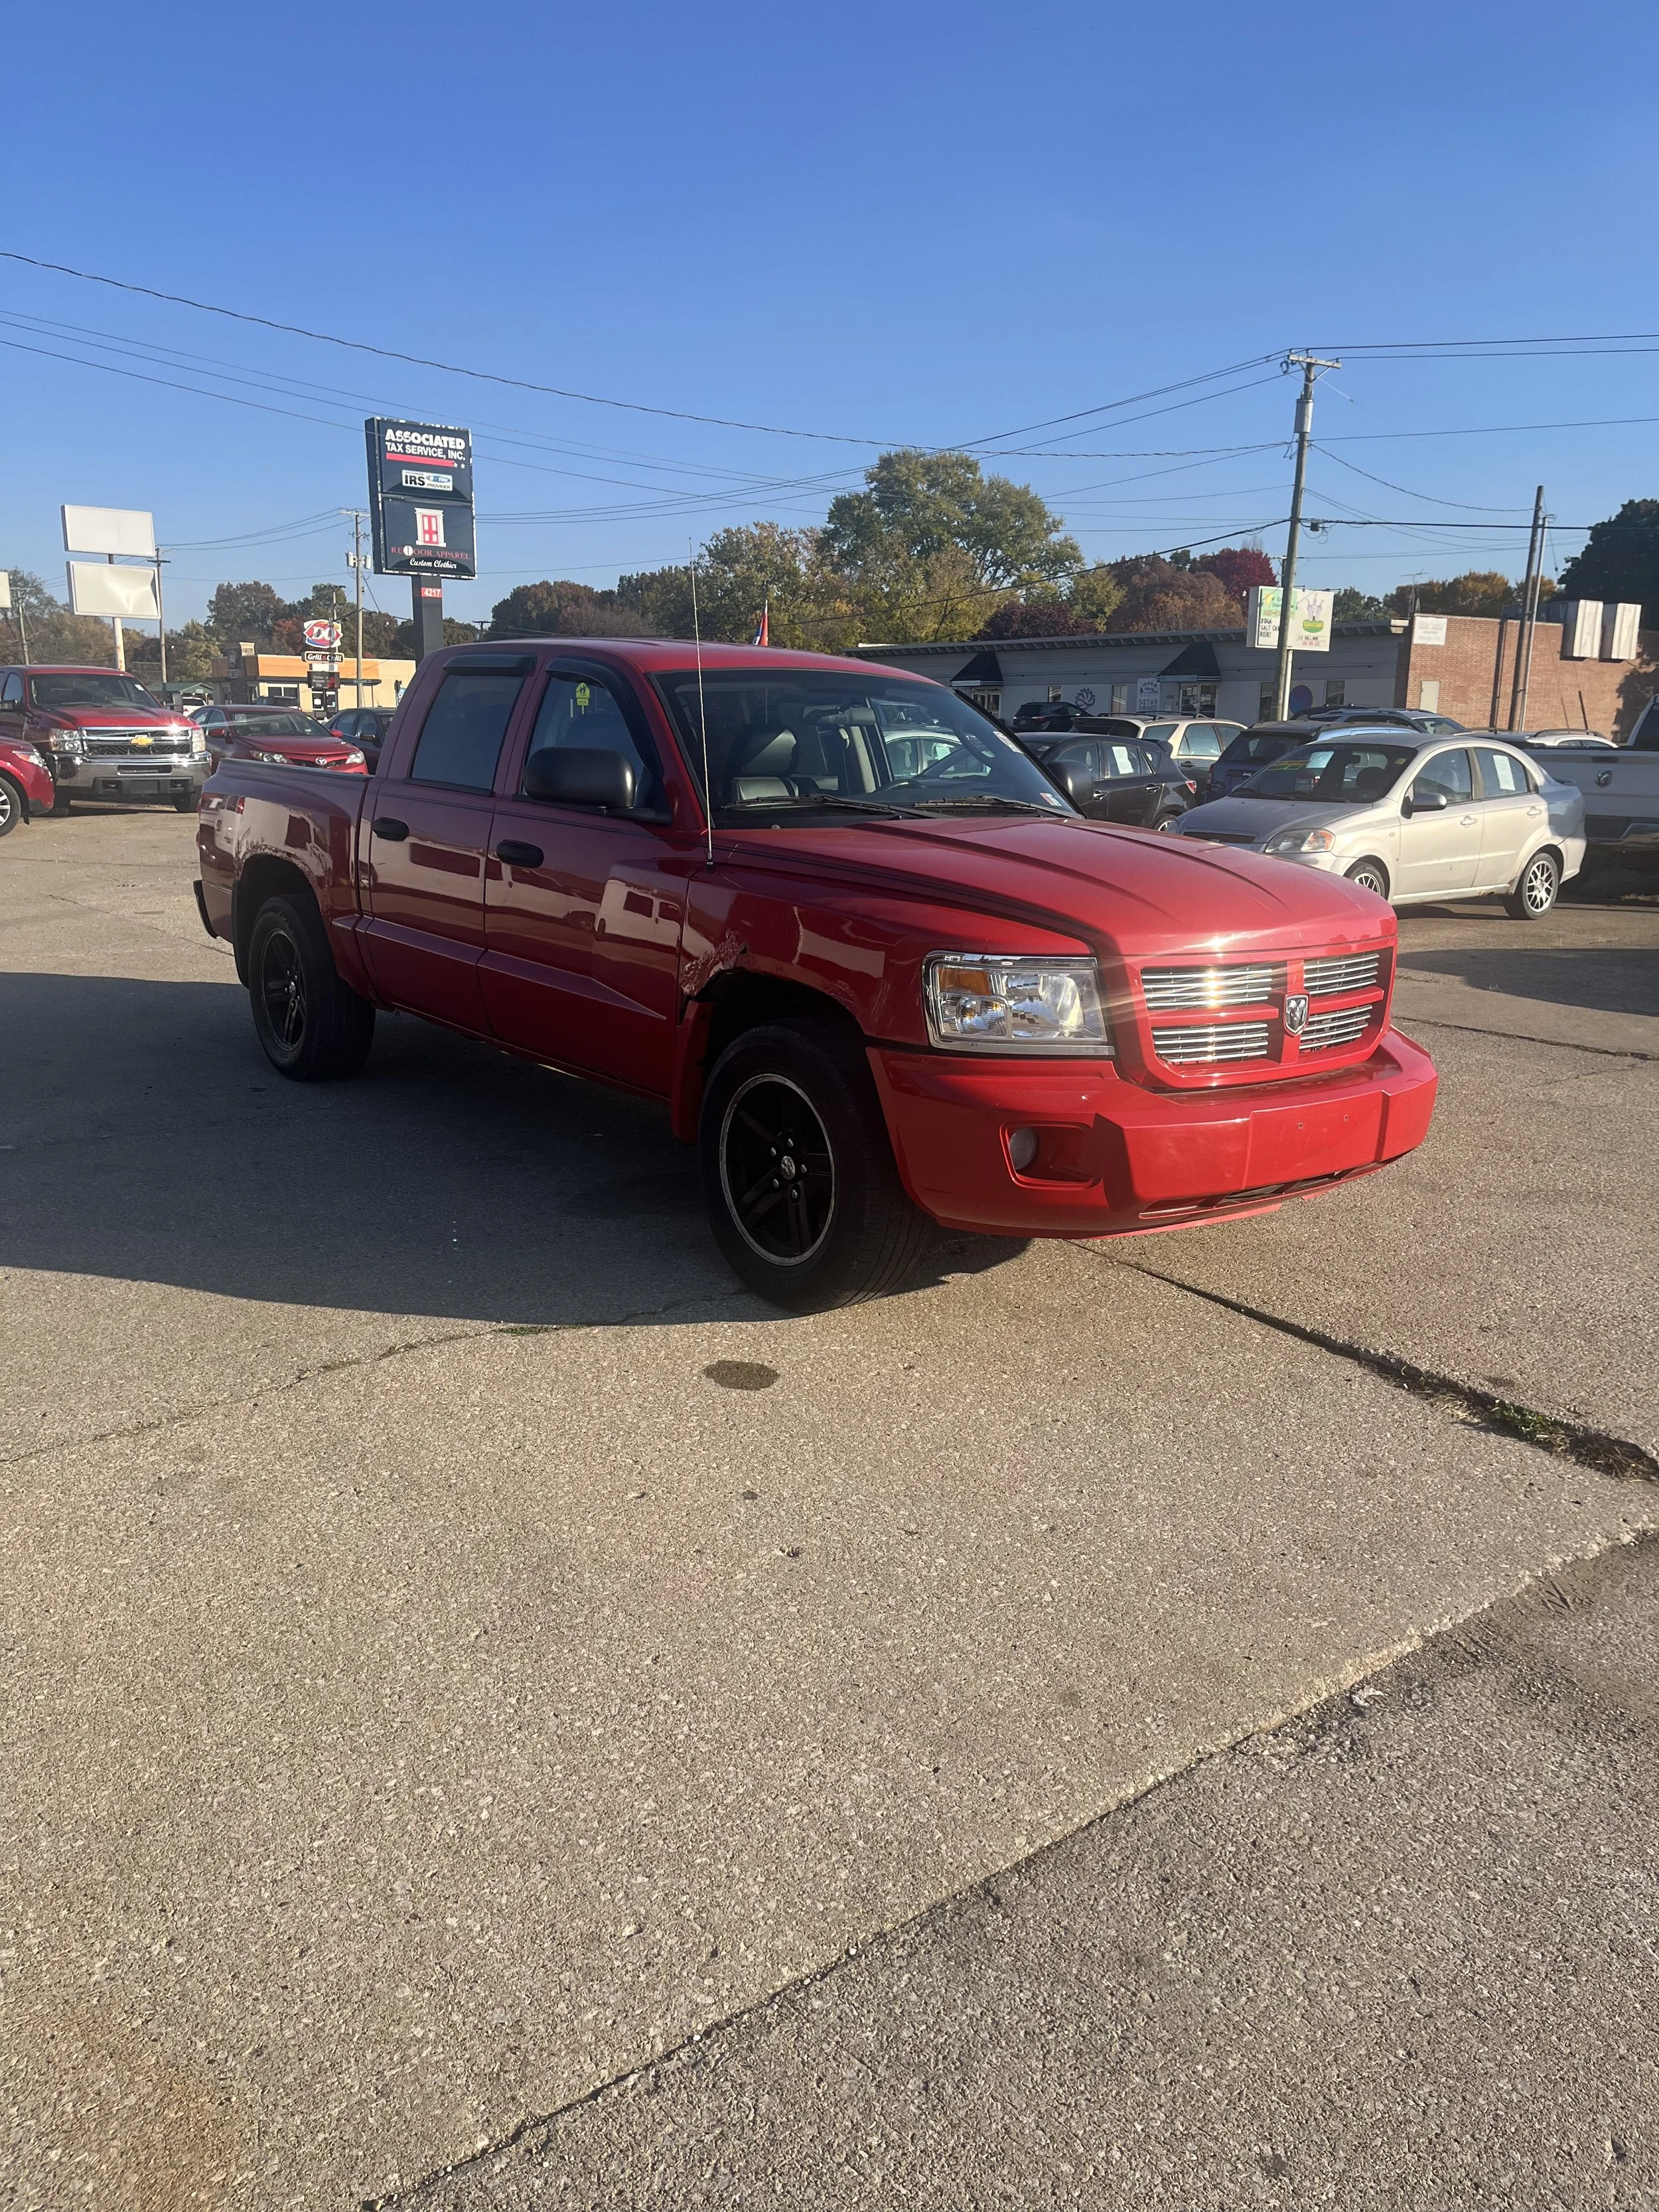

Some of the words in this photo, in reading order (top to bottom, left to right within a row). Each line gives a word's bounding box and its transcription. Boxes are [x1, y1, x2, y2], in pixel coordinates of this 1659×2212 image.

[385, 429, 466, 450] ASSOCIATED
[385, 441, 404, 453] TAX
[405, 444, 446, 459] SERVICE,
[448, 449, 466, 461] INC.
[405, 475, 425, 486] IRS
[435, 551, 469, 560] APPAREL
[409, 557, 433, 567] Custom
[433, 559, 457, 569] Clothier
[424, 588, 441, 597] 4217
[313, 626, 336, 642] DQ
